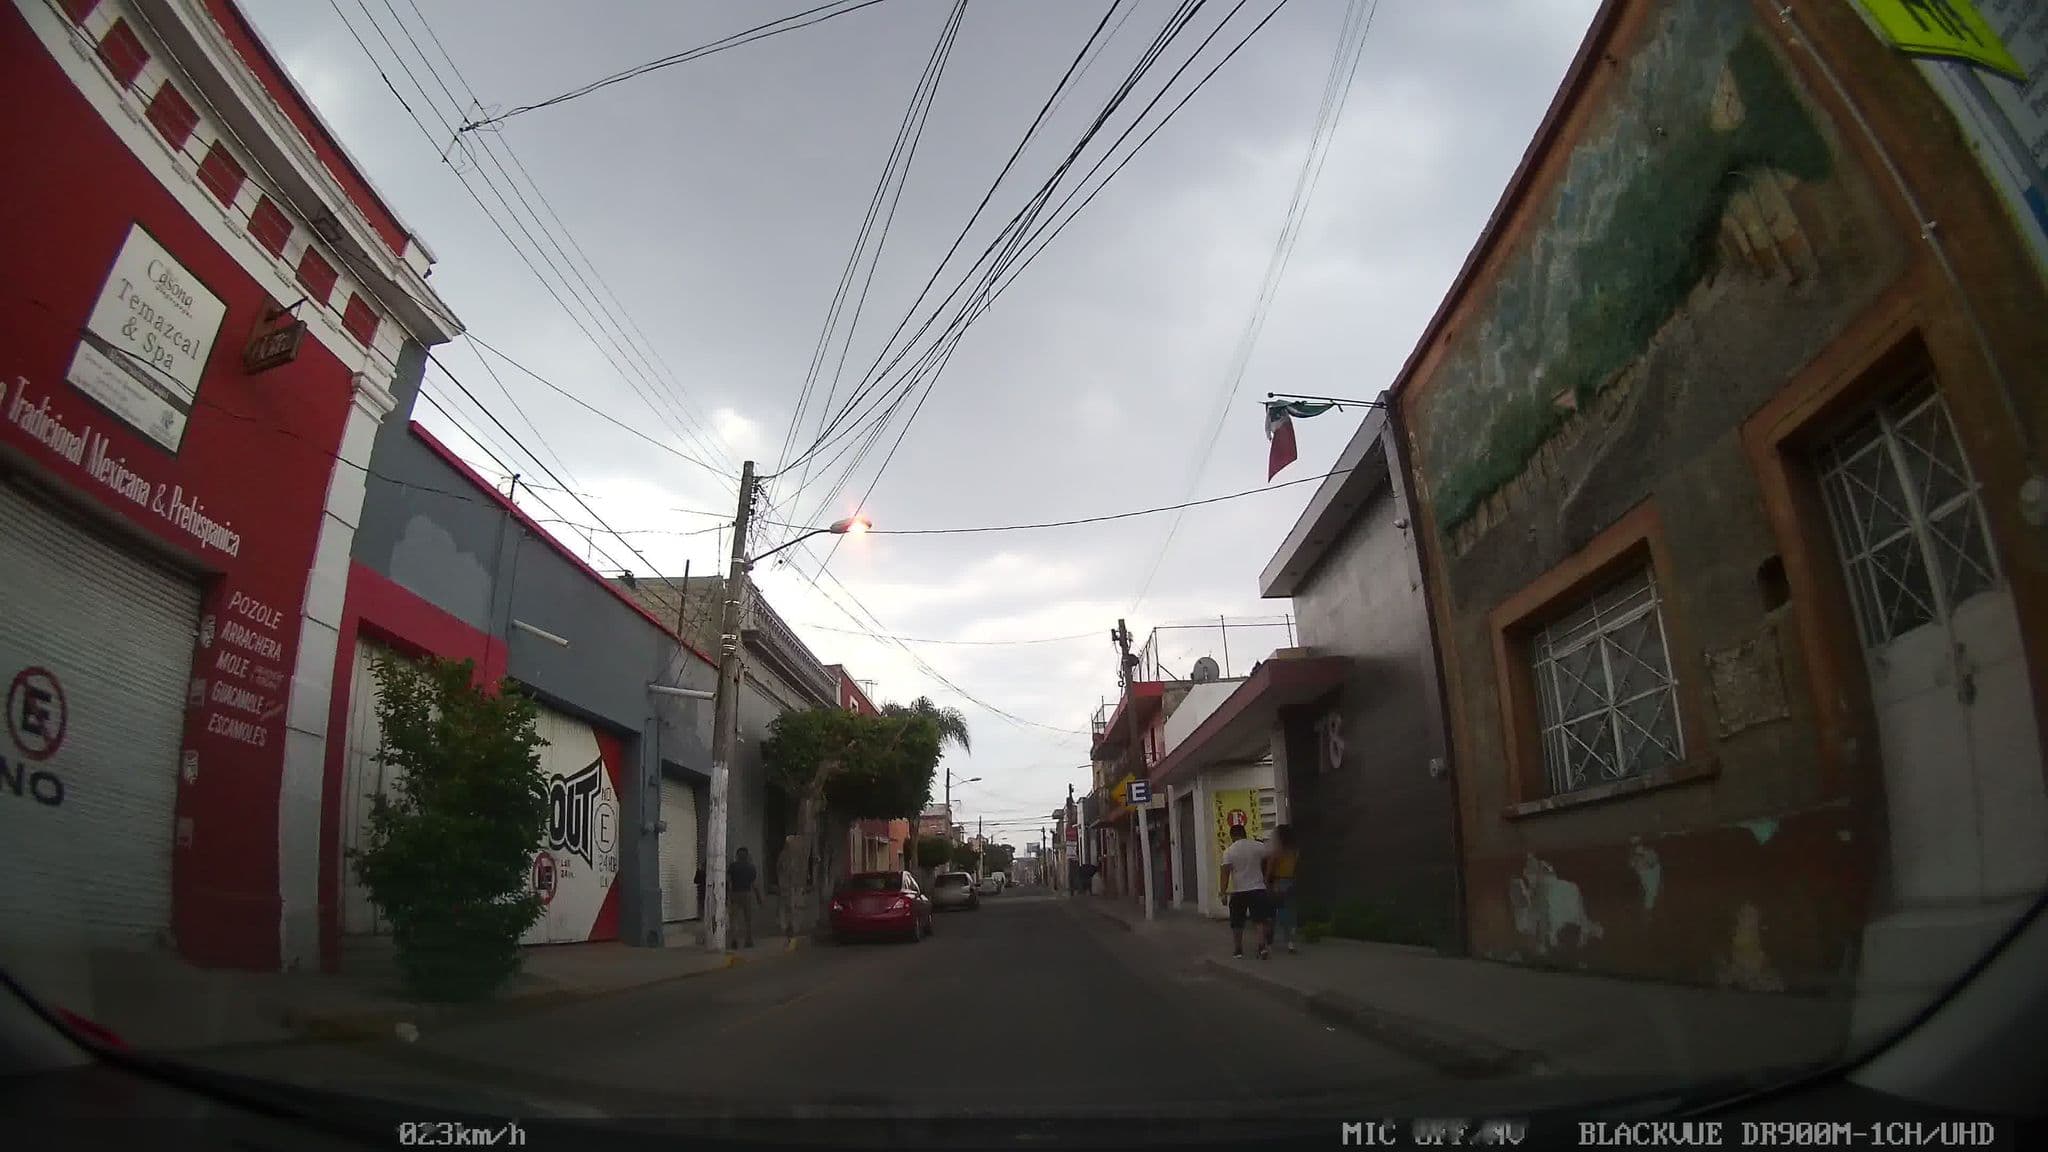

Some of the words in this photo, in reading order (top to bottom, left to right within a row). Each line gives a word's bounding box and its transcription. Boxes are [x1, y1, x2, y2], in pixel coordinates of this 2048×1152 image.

[146, 258, 194, 308] Casona
[117, 277, 201, 360] Temazcal
[121, 316, 138, 342] &
[142, 332, 175, 371] Spa
[8, 376, 91, 466] Tradicional
[85, 432, 151, 507] Mexicana
[152, 483, 166, 517] &
[228, 590, 284, 630] POZOLE
[220, 620, 282, 661] ARRACHERA
[216, 650, 250, 679] MOLE
[22, 687, 53, 737] E
[207, 713, 268, 747] ESCAMOLES
[1131, 782, 1147, 802] E
[601, 813, 610, 844] E
